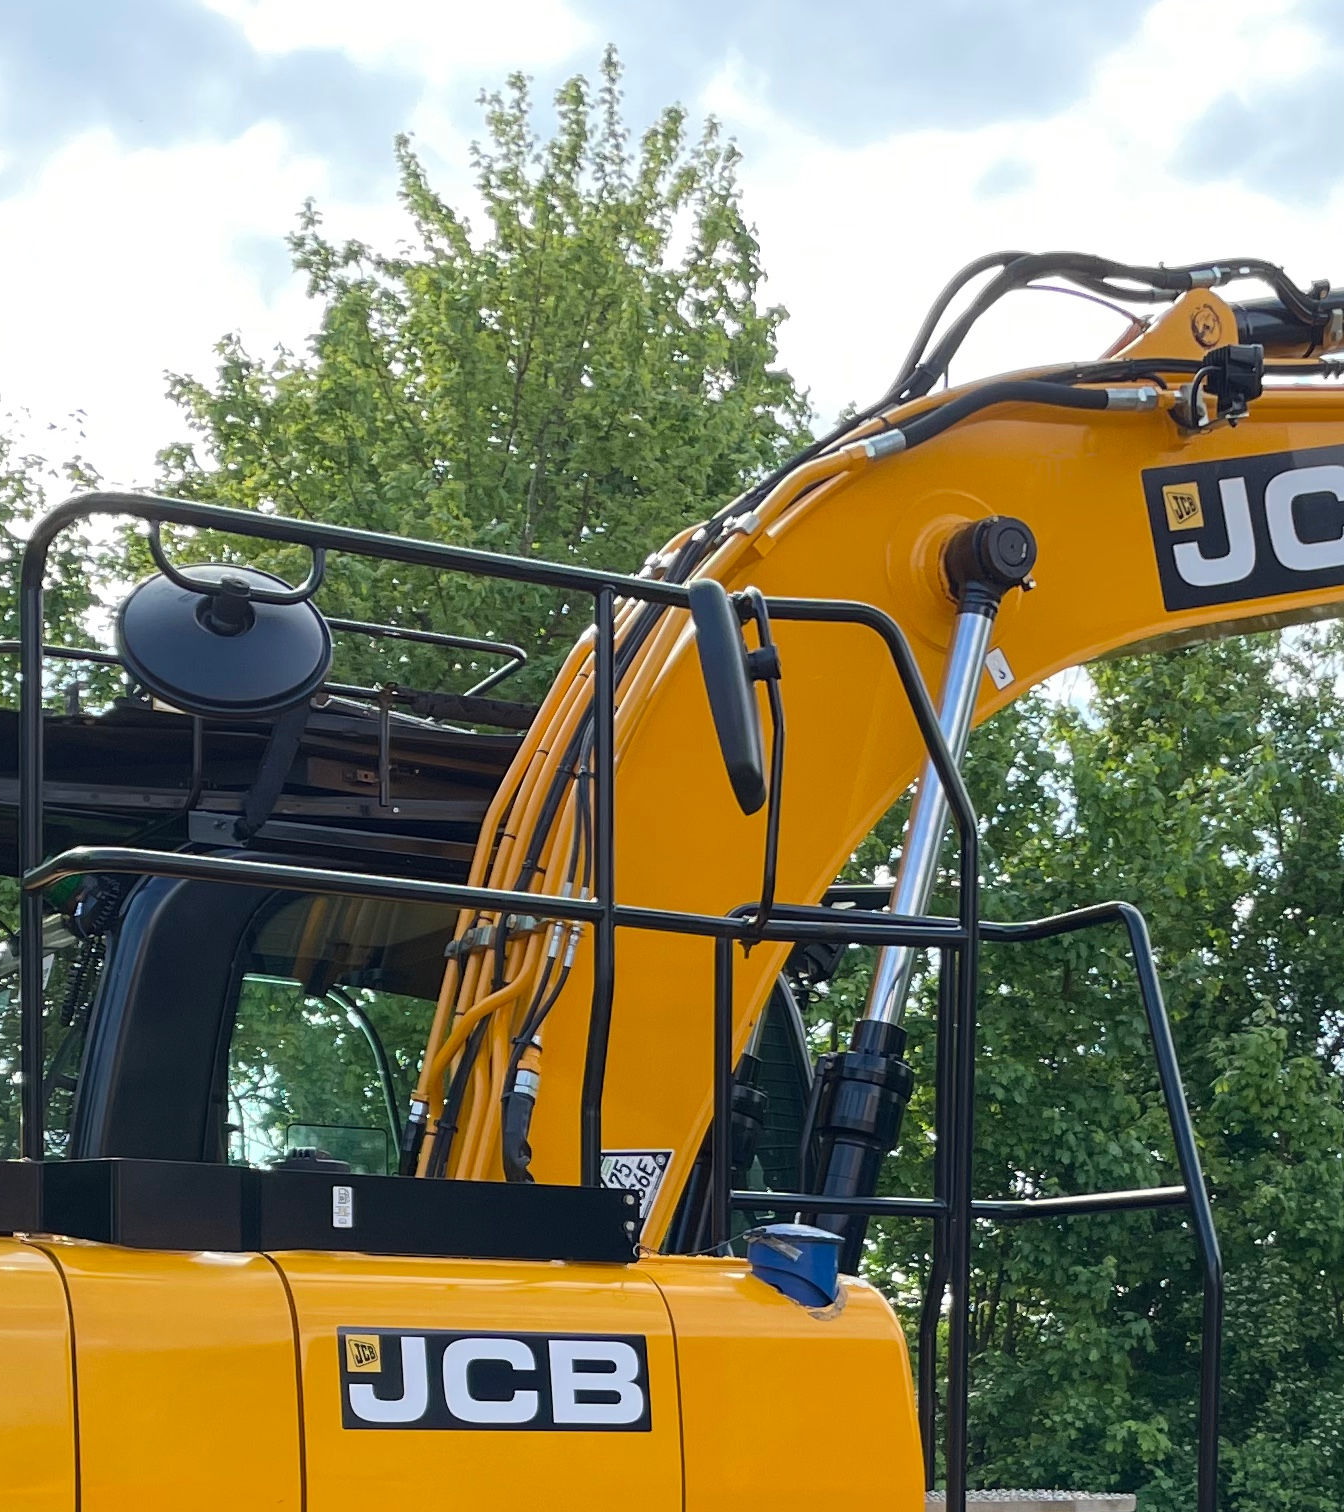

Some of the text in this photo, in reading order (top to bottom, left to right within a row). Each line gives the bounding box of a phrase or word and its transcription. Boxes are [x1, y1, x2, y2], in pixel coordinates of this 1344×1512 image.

[1171, 492, 1198, 522] JCB
[354, 1342, 377, 1365] JCB
[348, 1336, 645, 1425] JCB
